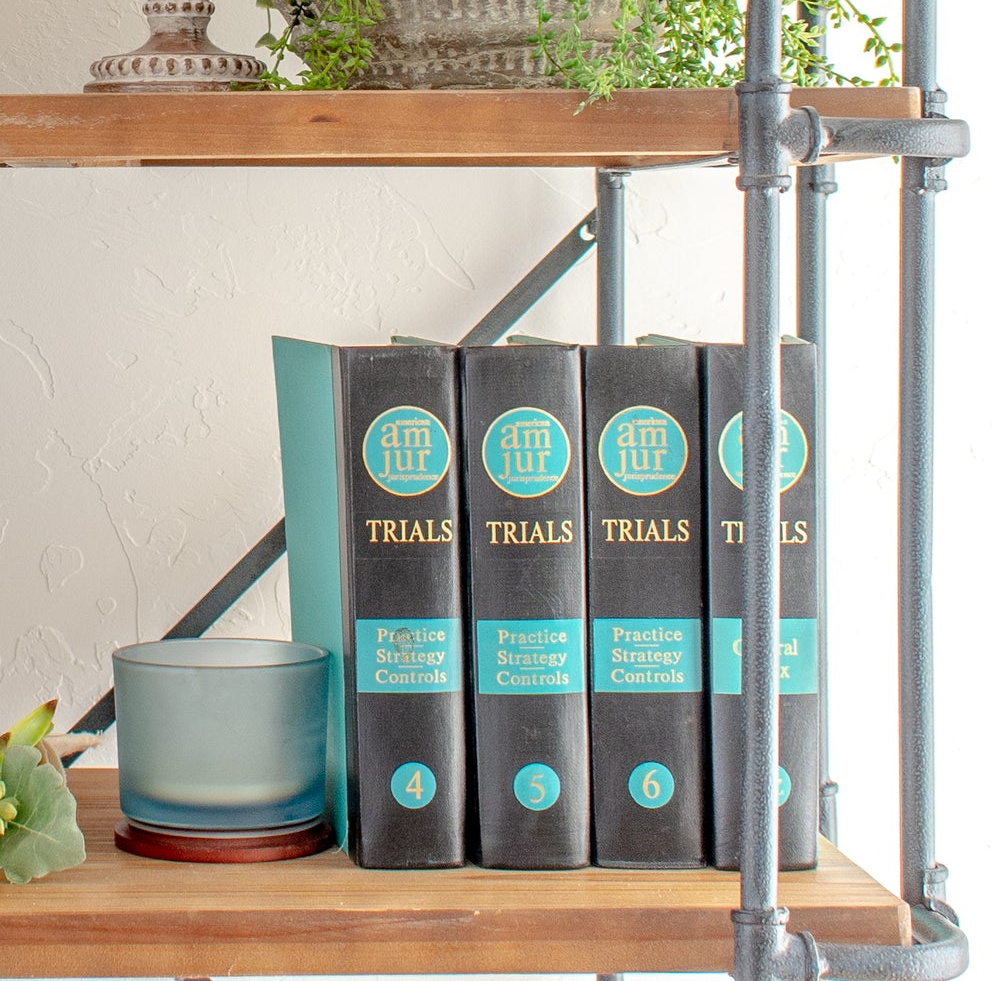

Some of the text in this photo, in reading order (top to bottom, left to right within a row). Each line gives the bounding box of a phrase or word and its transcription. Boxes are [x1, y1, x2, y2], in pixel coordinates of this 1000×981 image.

[380, 422, 432, 448] am
[500, 424, 552, 449] am
[617, 422, 668, 447] am
[379, 449, 431, 478] jur
[498, 450, 551, 480] jur
[614, 448, 668, 477] jur
[366, 520, 453, 543] TRIALS
[486, 520, 573, 544] TRIALS
[602, 519, 690, 543] TRIALS
[497, 629, 567, 644] Practice
[612, 627, 683, 643] Practice
[376, 648, 446, 665] Strategy
[497, 651, 567, 666] Strategy
[612, 648, 683, 664] Strategy
[375, 669, 448, 684] Controls
[496, 671, 569, 686] Controls
[610, 668, 684, 684] Controls
[405, 770, 424, 800] 4
[530, 773, 546, 803] 5
[642, 769, 661, 799] 6
